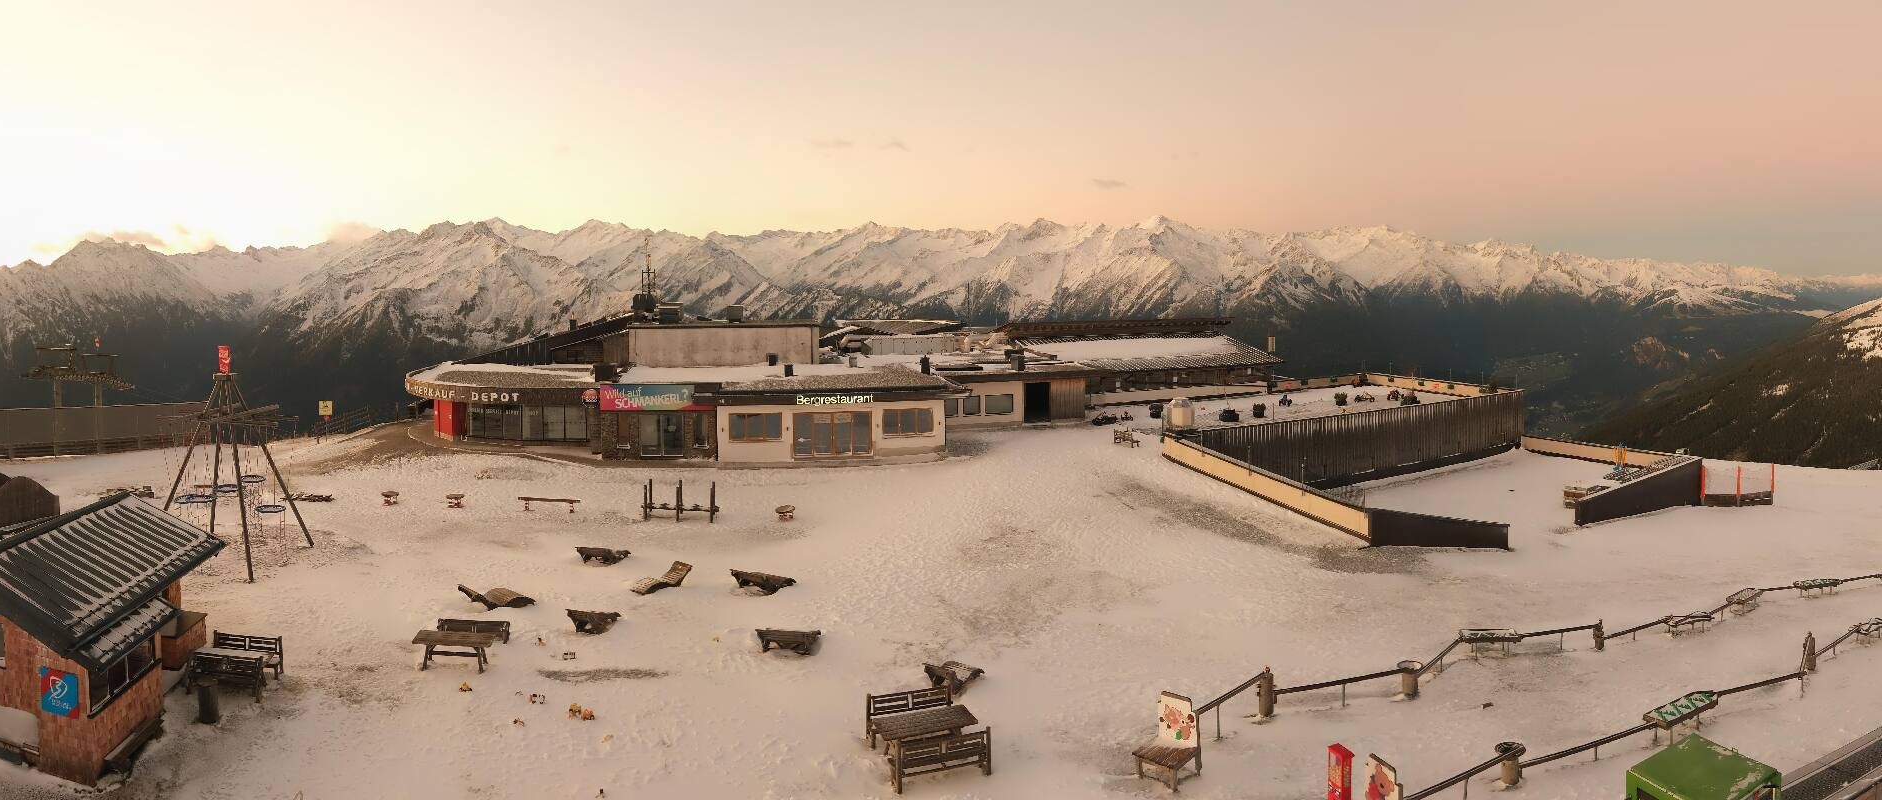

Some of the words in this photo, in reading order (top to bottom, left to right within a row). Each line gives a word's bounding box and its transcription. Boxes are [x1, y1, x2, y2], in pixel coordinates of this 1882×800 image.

[414, 386, 455, 398] VERKAUF
[471, 392, 520, 401] DEPOT
[605, 388, 625, 400] Wild
[628, 387, 642, 397] auf
[614, 388, 689, 409] SCHMANKERL?
[796, 394, 873, 406] Bergrestaurant
